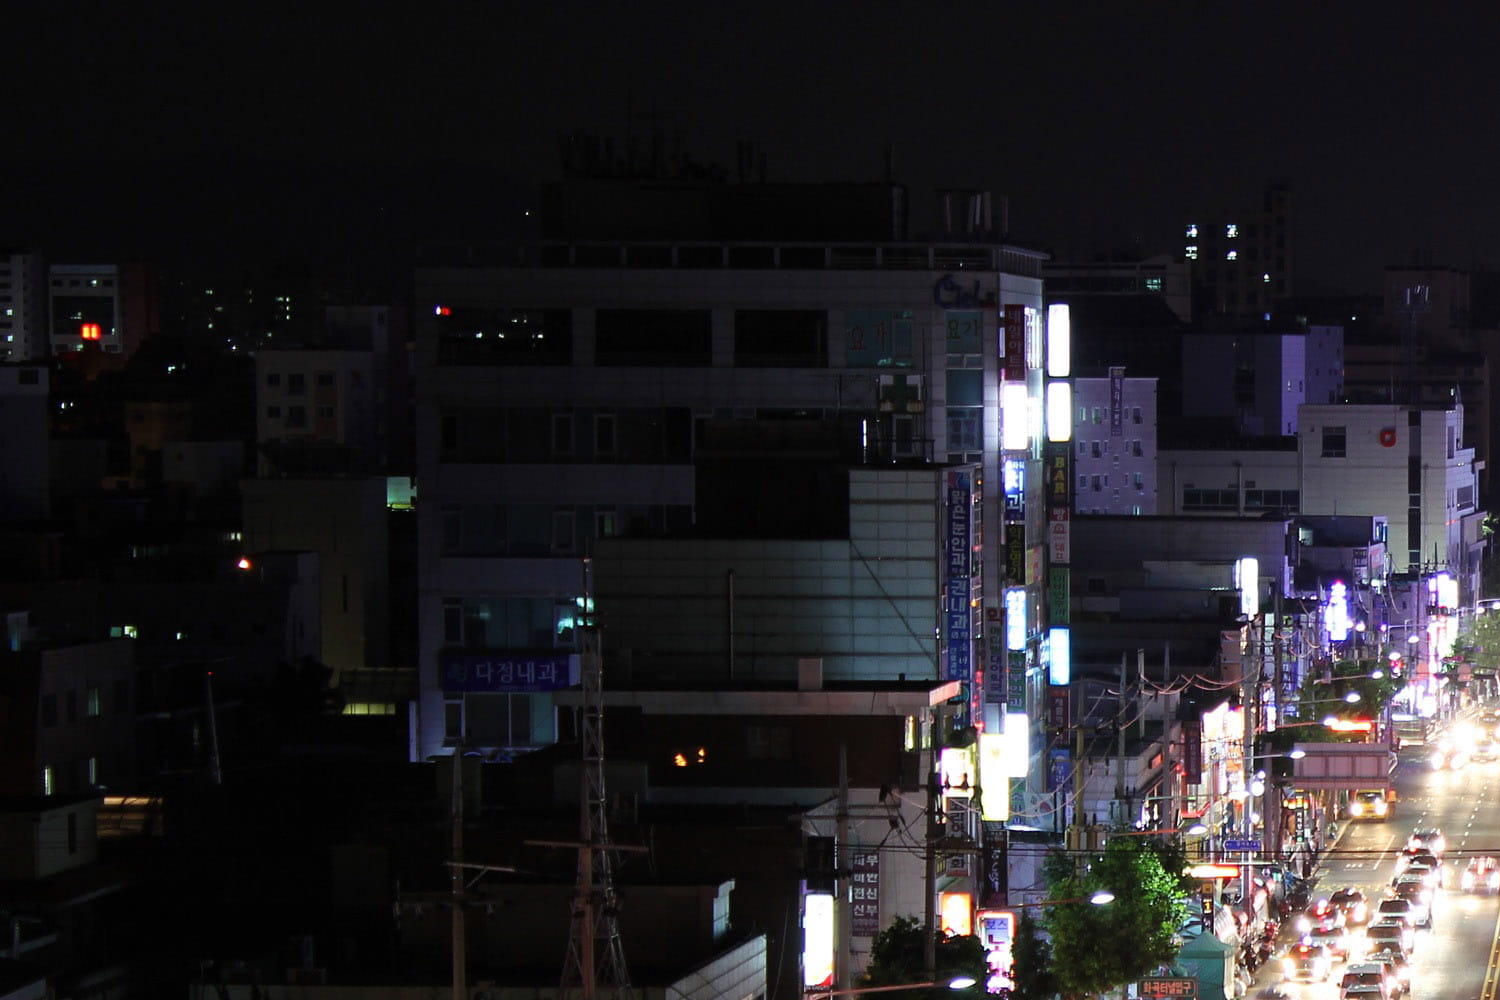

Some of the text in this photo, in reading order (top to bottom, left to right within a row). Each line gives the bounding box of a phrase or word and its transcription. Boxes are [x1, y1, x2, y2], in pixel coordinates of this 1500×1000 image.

[1054, 456, 1067, 494] BAR
[987, 607, 1004, 624] 약
[853, 887, 879, 901] 전신
[1143, 981, 1193, 996] 화곡터널입구
